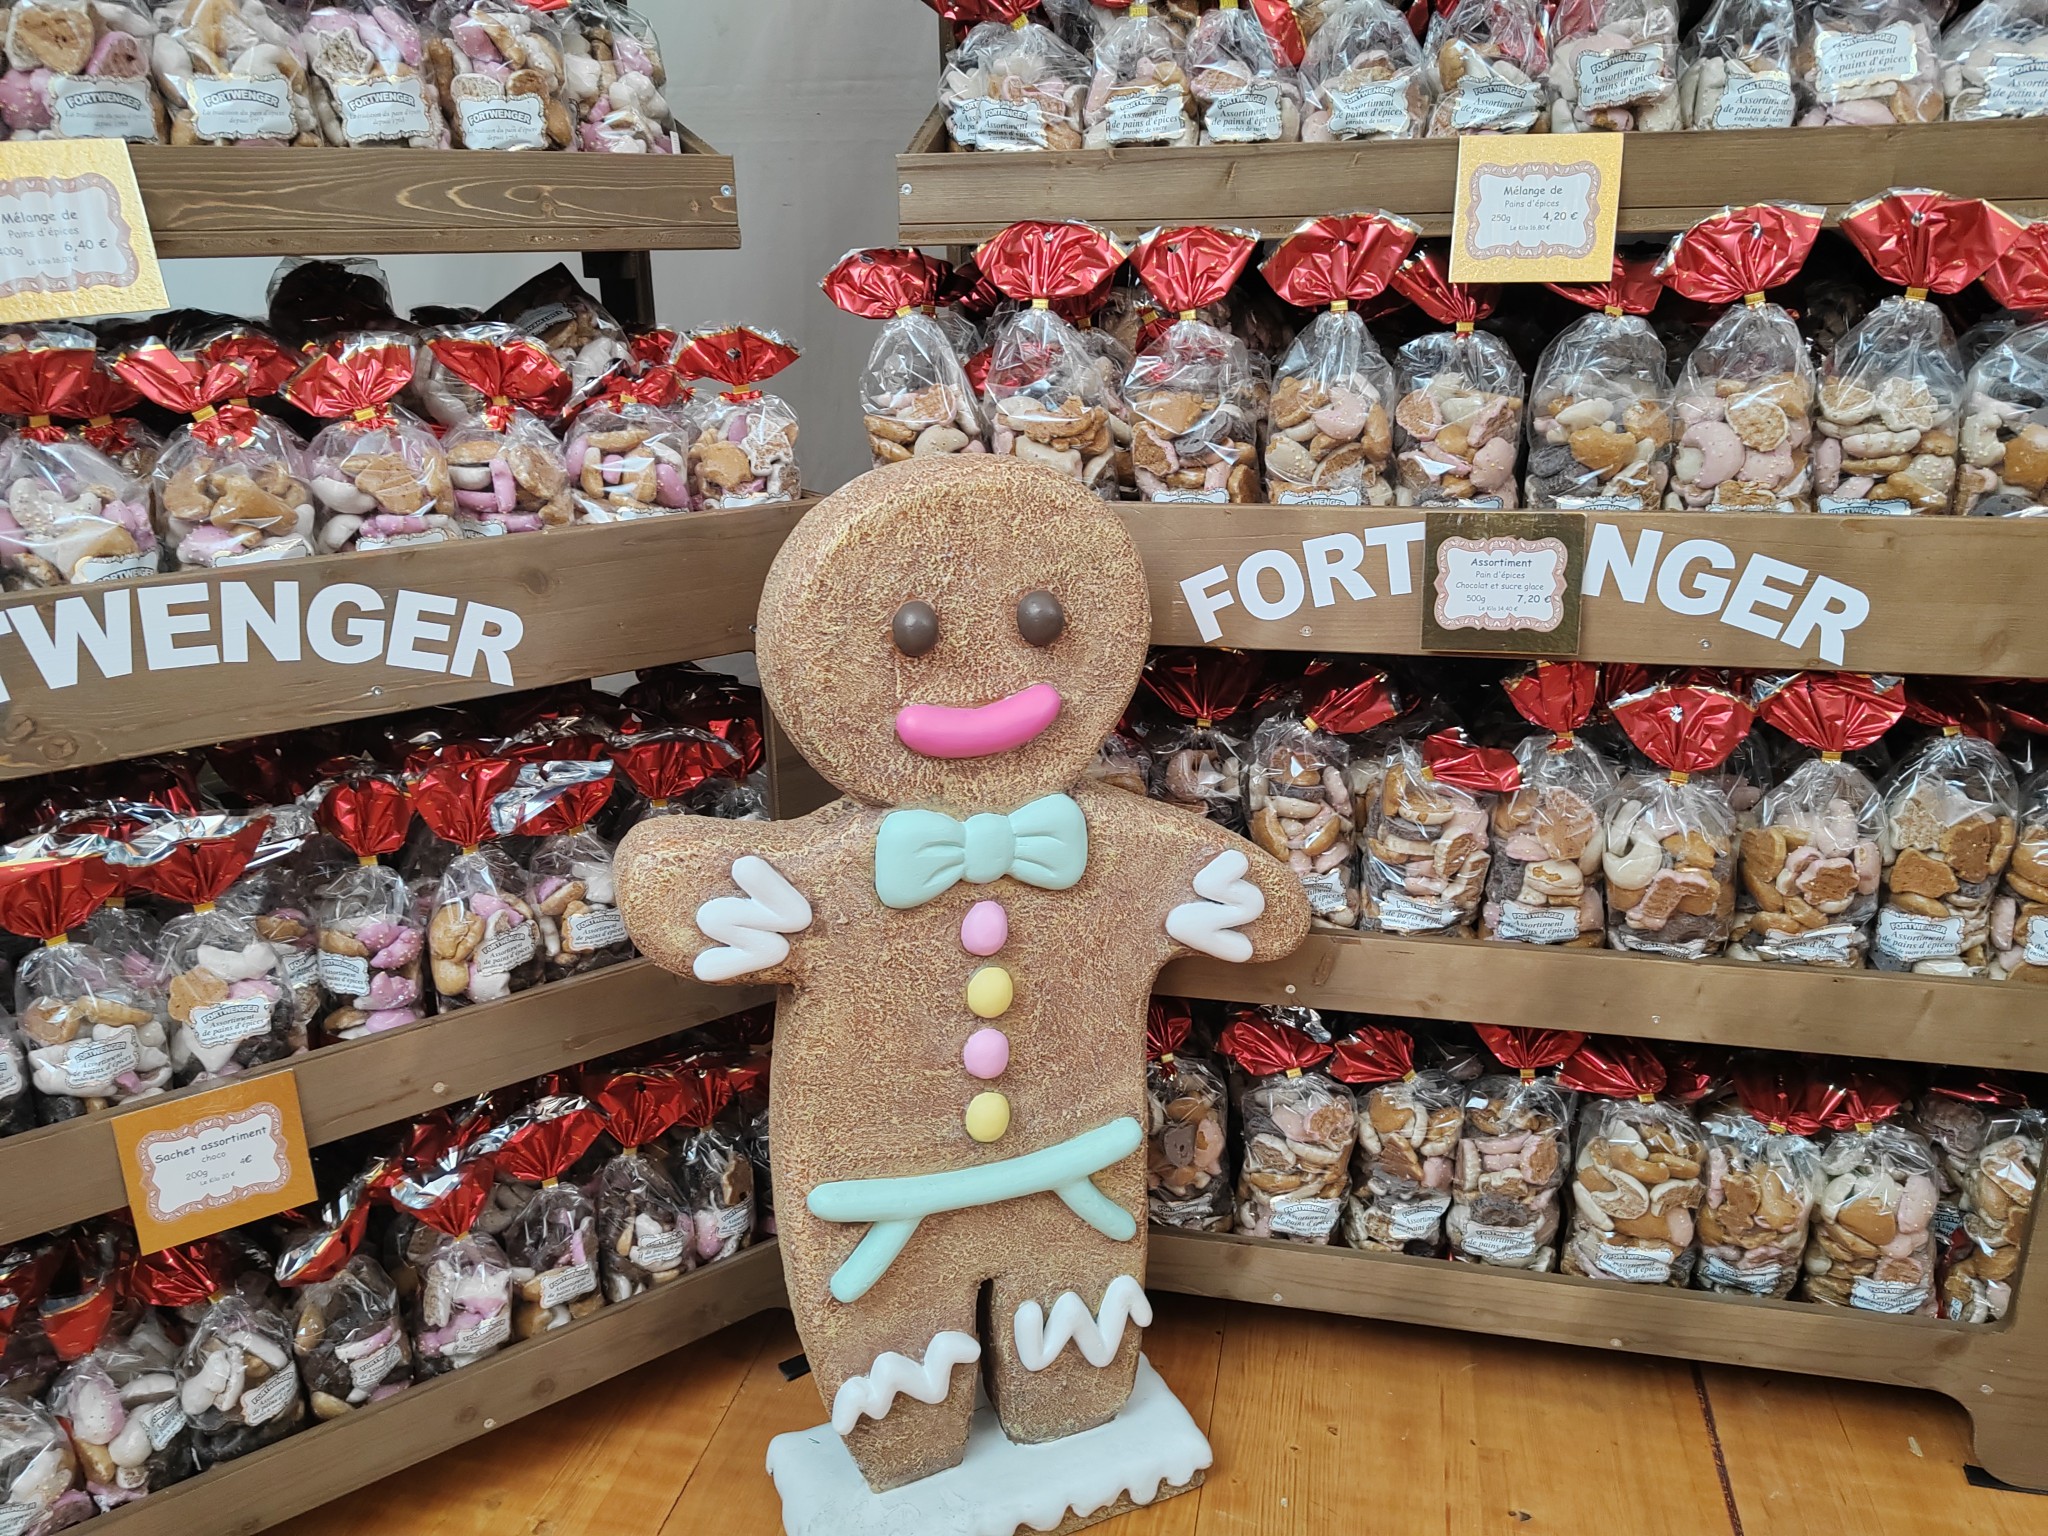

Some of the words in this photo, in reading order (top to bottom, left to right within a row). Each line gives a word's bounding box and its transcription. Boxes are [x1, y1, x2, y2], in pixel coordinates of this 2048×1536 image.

[1837, 46, 1896, 62] Assortiment
[1591, 53, 1647, 74] FORTWENGER
[1824, 65, 1836, 74] de
[1839, 61, 1866, 73] pains
[1869, 54, 1907, 68] d'épices
[1592, 64, 1645, 84] Assortiment
[1583, 85, 1591, 94] de
[1594, 82, 1618, 95] pains
[1621, 72, 1655, 87] d'épices
[1473, 84, 1527, 99] FORTWENGER
[65, 91, 141, 111] FORTWENGER
[203, 89, 280, 108] FORTWENGER
[348, 91, 415, 111] FORTWENGER
[1473, 98, 1524, 108] Assortiment
[1472, 107, 1495, 115] pains
[1723, 104, 1734, 113] de
[1735, 105, 1762, 116] pains
[1764, 105, 1792, 116] d'épices
[467, 109, 531, 126] FORTWENGER
[1112, 120, 1121, 128] de
[1122, 120, 1144, 130] pains
[1146, 115, 1178, 127] d'épices
[1503, 186, 1545, 198] Mélange
[1550, 185, 1563, 195] de
[1527, 200, 1560, 209] d'épices
[1, 211, 56, 225] Mélange
[61, 209, 78, 220] de
[1491, 214, 1511, 222] 250g
[1543, 212, 1566, 222] 4,20
[1571, 211, 1579, 221] €
[8, 229, 34, 239] Pains
[38, 227, 79, 239] d'épices
[64, 240, 94, 252] 6,40
[98, 238, 108, 248] €
[1471, 558, 1533, 567] Assortiment
[1475, 571, 1491, 579] Pain
[1493, 571, 1526, 580] d'épices
[1455, 581, 1488, 590] Chocolat
[1490, 582, 1499, 590] et
[1524, 582, 1544, 591] glace
[1466, 595, 1486, 604] 500g
[1517, 595, 1541, 604] 7,20
[1544, 595, 1551, 604] €
[0, 581, 524, 704] WENGER
[1514, 920, 1563, 928] Assortiment
[1890, 922, 1947, 935] FORTWENGER
[1891, 931, 1945, 941] Assortiment
[1893, 938, 1917, 949] pains
[1919, 941, 1953, 950] d'épices
[201, 1005, 259, 1024] FORTWENGER
[209, 1014, 255, 1028] Assortiment
[213, 1025, 232, 1036] pains
[235, 1019, 264, 1029] d'épices
[155, 1146, 195, 1164] Sachet
[201, 1126, 267, 1151] assortiment
[201, 1152, 226, 1163] choco
[186, 1169, 208, 1180] 200g
